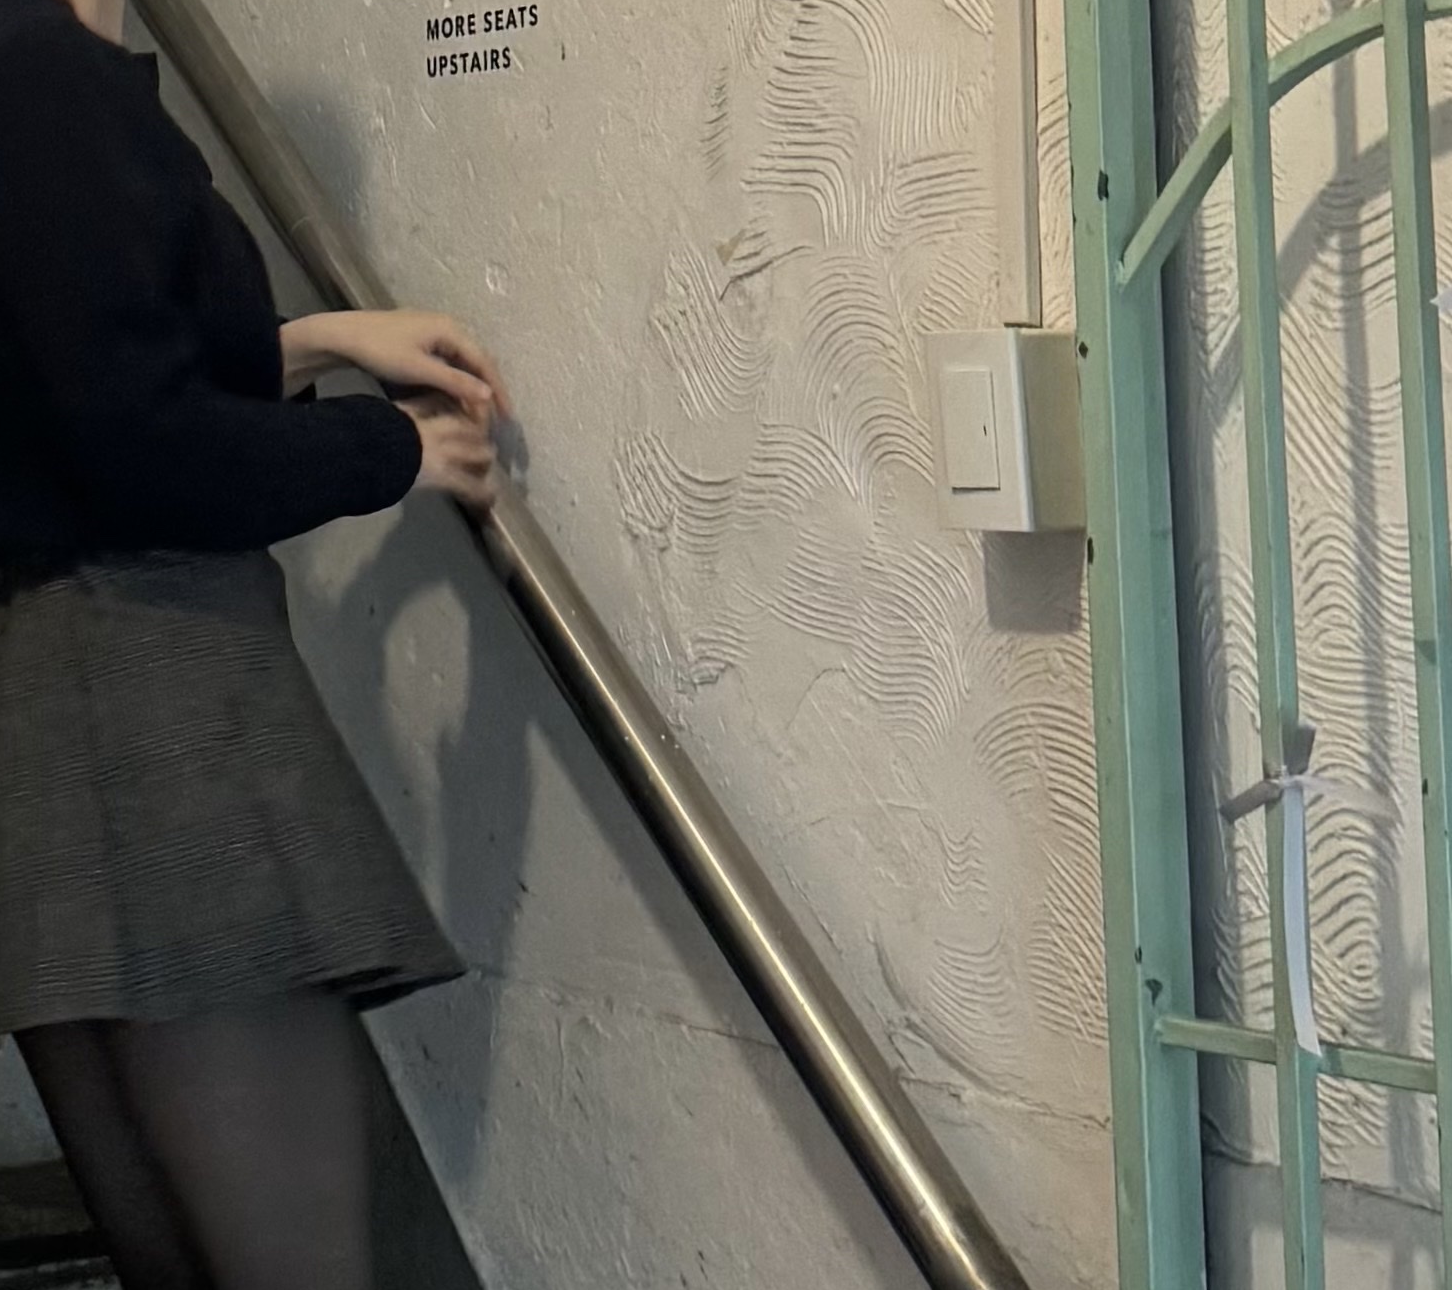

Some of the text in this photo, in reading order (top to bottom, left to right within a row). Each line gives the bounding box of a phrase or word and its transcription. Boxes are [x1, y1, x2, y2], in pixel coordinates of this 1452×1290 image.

[426, 4, 539, 42] MORE SEATS
[426, 47, 512, 79] UPSTAIRS
